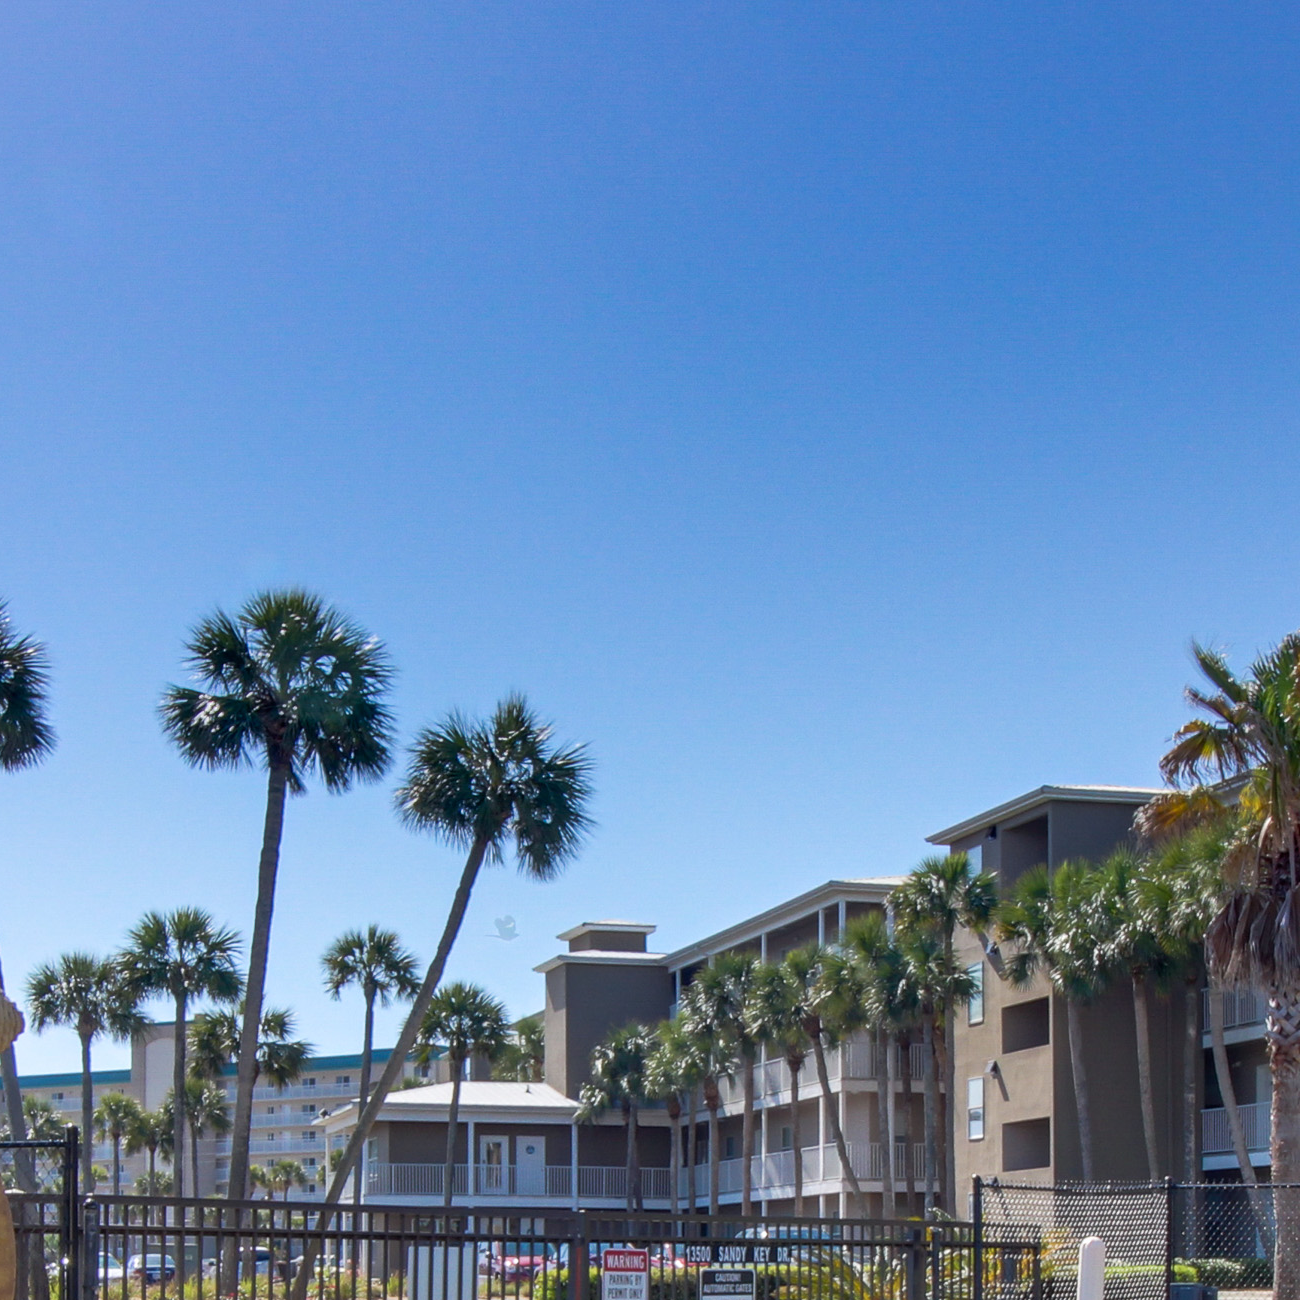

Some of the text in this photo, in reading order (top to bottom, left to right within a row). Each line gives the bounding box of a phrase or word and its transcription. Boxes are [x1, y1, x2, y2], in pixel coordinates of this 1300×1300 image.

[686, 1246, 790, 1262] 13500 SANDY KEY DR.
[607, 1255, 645, 1269] WARNING
[609, 1274, 643, 1285] PARKING BY
[607, 1288, 627, 1299] PERMIT
